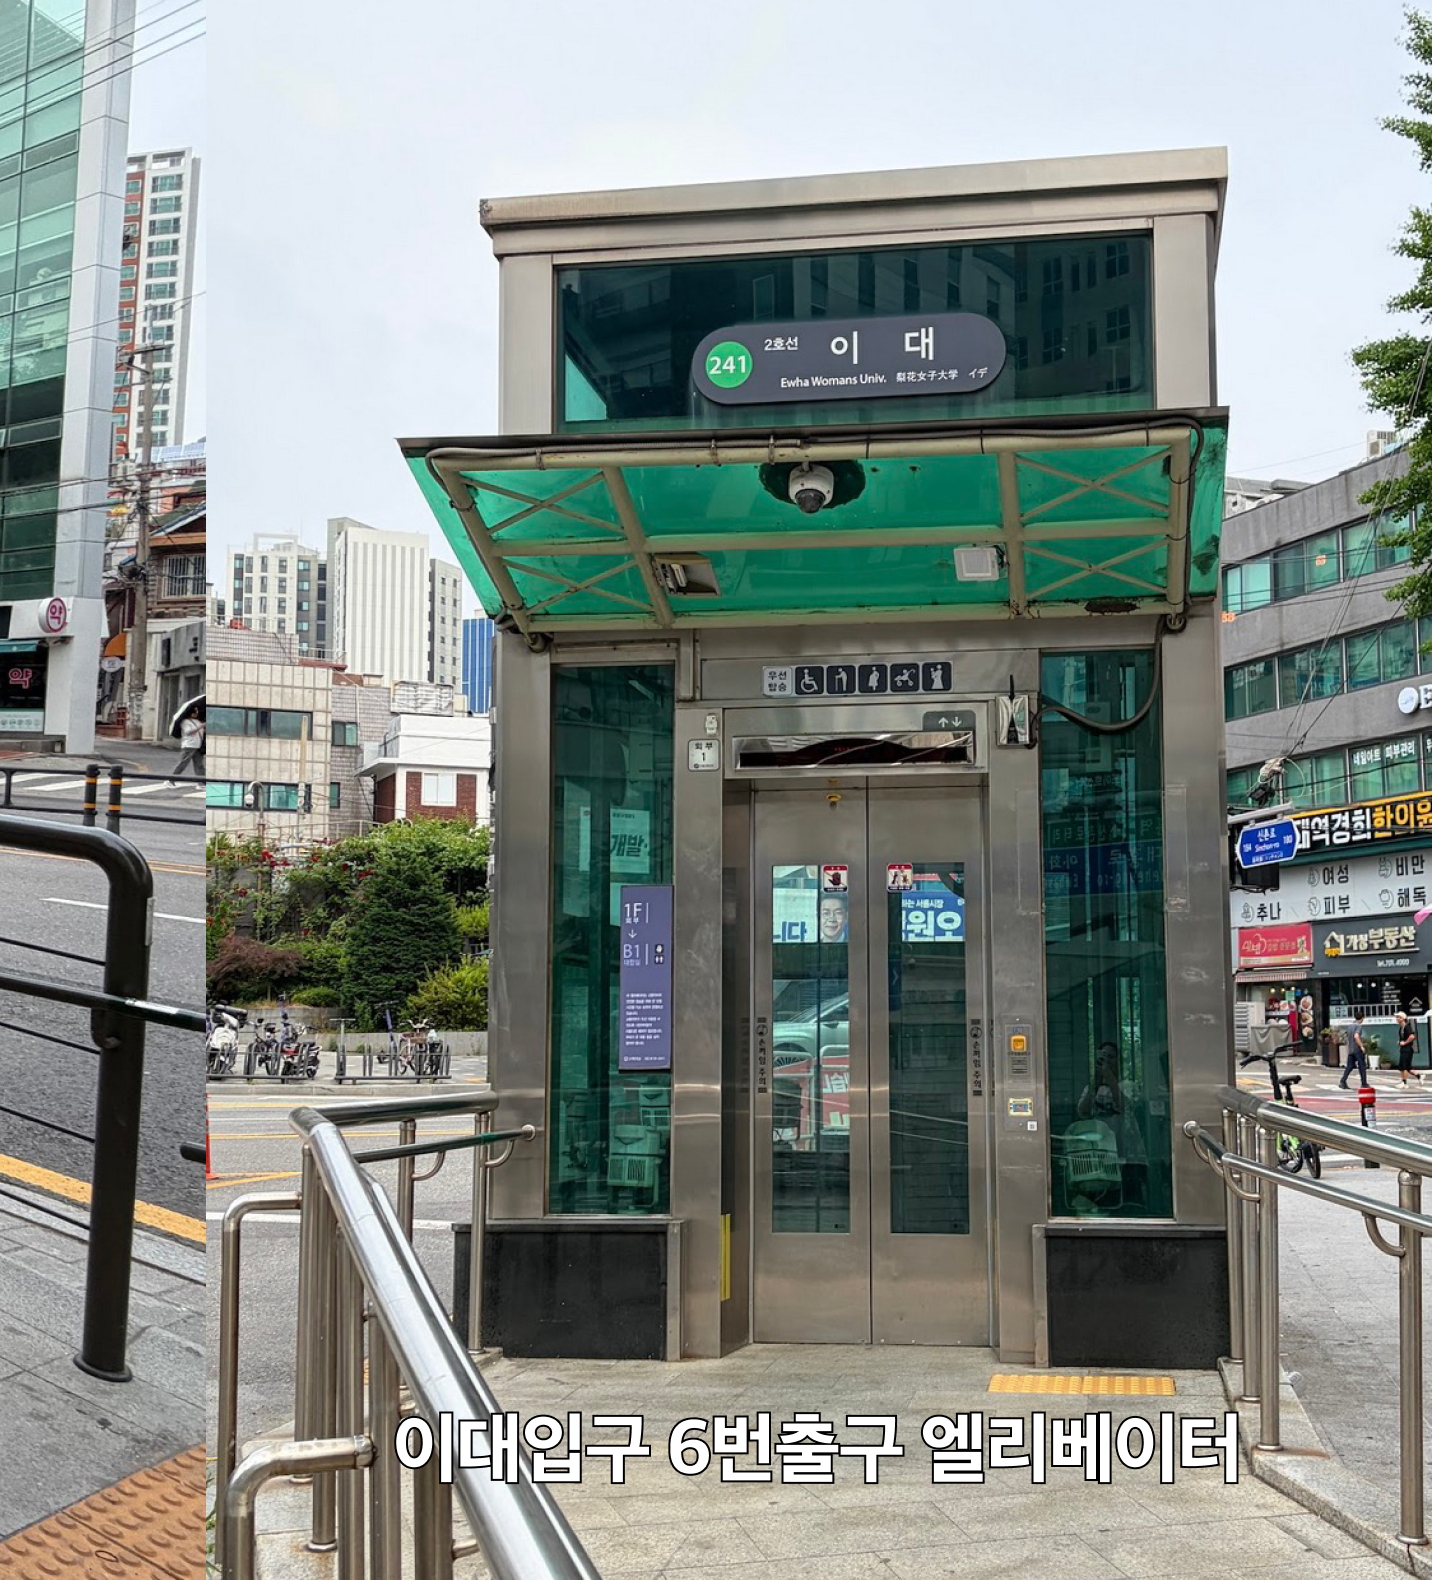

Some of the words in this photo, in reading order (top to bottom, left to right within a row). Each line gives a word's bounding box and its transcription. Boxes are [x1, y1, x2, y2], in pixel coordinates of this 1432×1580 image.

[764, 336, 799, 351] 2호선
[708, 355, 747, 375] 241
[780, 376, 809, 388] Ewha
[811, 374, 857, 387] Womans
[859, 373, 887, 385] Univ.
[895, 368, 958, 384] 梨花女子大学
[49, 605, 63, 624] 약
[8, 668, 32, 689] 약
[768, 670, 788, 682] 우선
[1353, 748, 1381, 765] 네일아트
[1385, 740, 1415, 759] 피부관리
[1257, 828, 1276, 842] 신촌로
[1323, 864, 1349, 885] 여성
[1396, 854, 1426, 876] 비만
[624, 902, 642, 917] 1F
[1256, 901, 1281, 922] 추나
[1324, 894, 1351, 915] 피부
[1397, 886, 1427, 908] 해독
[623, 944, 640, 958] B1
